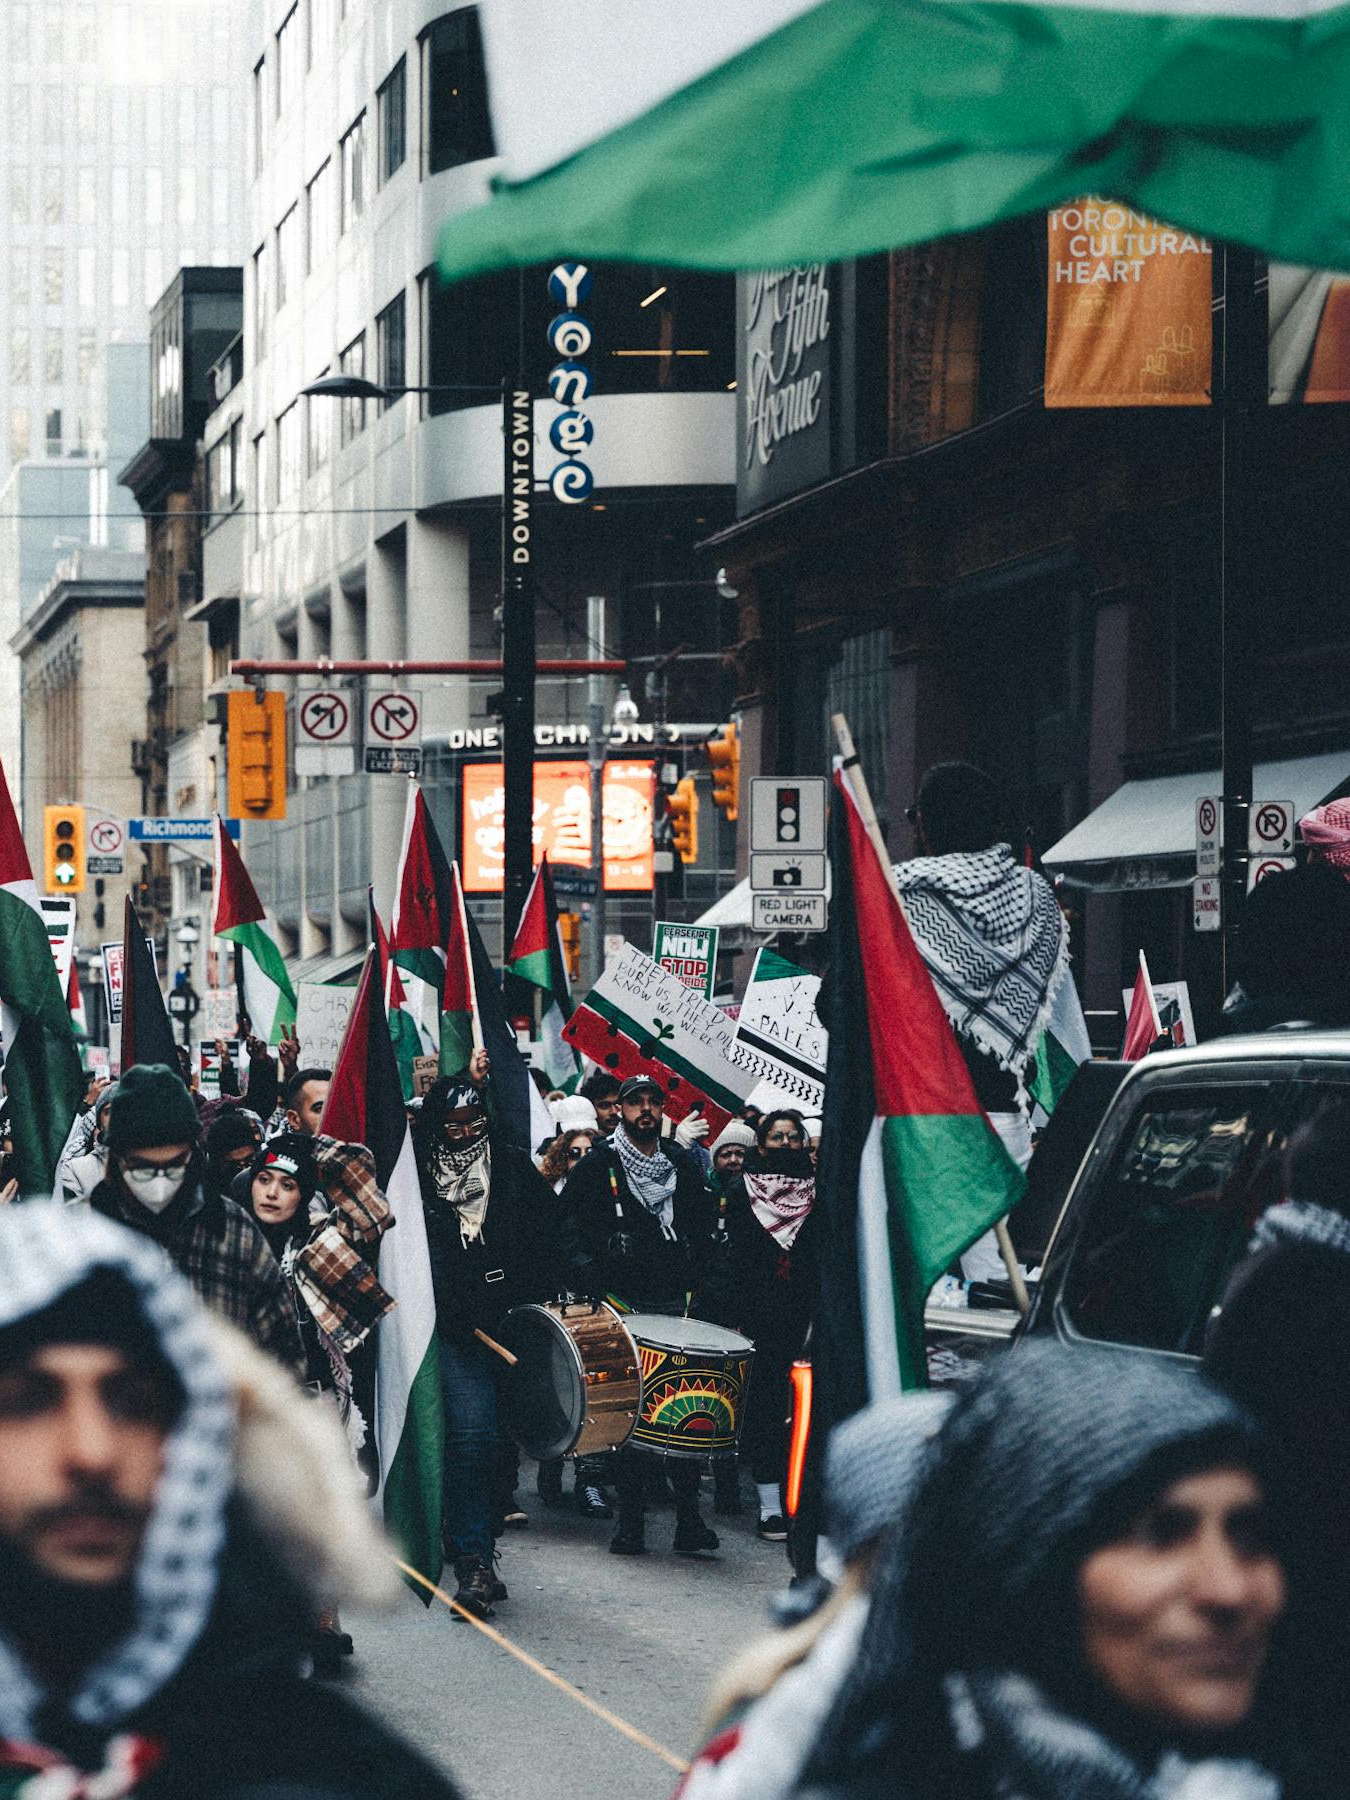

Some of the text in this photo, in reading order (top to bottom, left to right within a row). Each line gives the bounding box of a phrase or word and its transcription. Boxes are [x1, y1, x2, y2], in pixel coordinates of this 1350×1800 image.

[1050, 208, 1177, 232] TORON
[1070, 232, 1213, 257] CULTURAL
[1055, 259, 1146, 284] HEART
[549, 264, 593, 504] Yonge
[513, 391, 530, 564] DOWNTOWN
[450, 727, 499, 749] ONE
[143, 820, 213, 836] Richmond
[1202, 883, 1211, 895] NO
[760, 899, 818, 910] RED LIGHT
[764, 913, 813, 925] CAMERA
[663, 927, 710, 939] CEASEFIRE
[661, 936, 709, 959] NOW
[631, 949, 670, 985] THEY
[661, 958, 707, 976] STOP
[655, 986, 669, 1001] US
[612, 973, 651, 1001] KNOW
[681, 1020, 716, 1048] WERE
[760, 1014, 819, 1059] PALES
